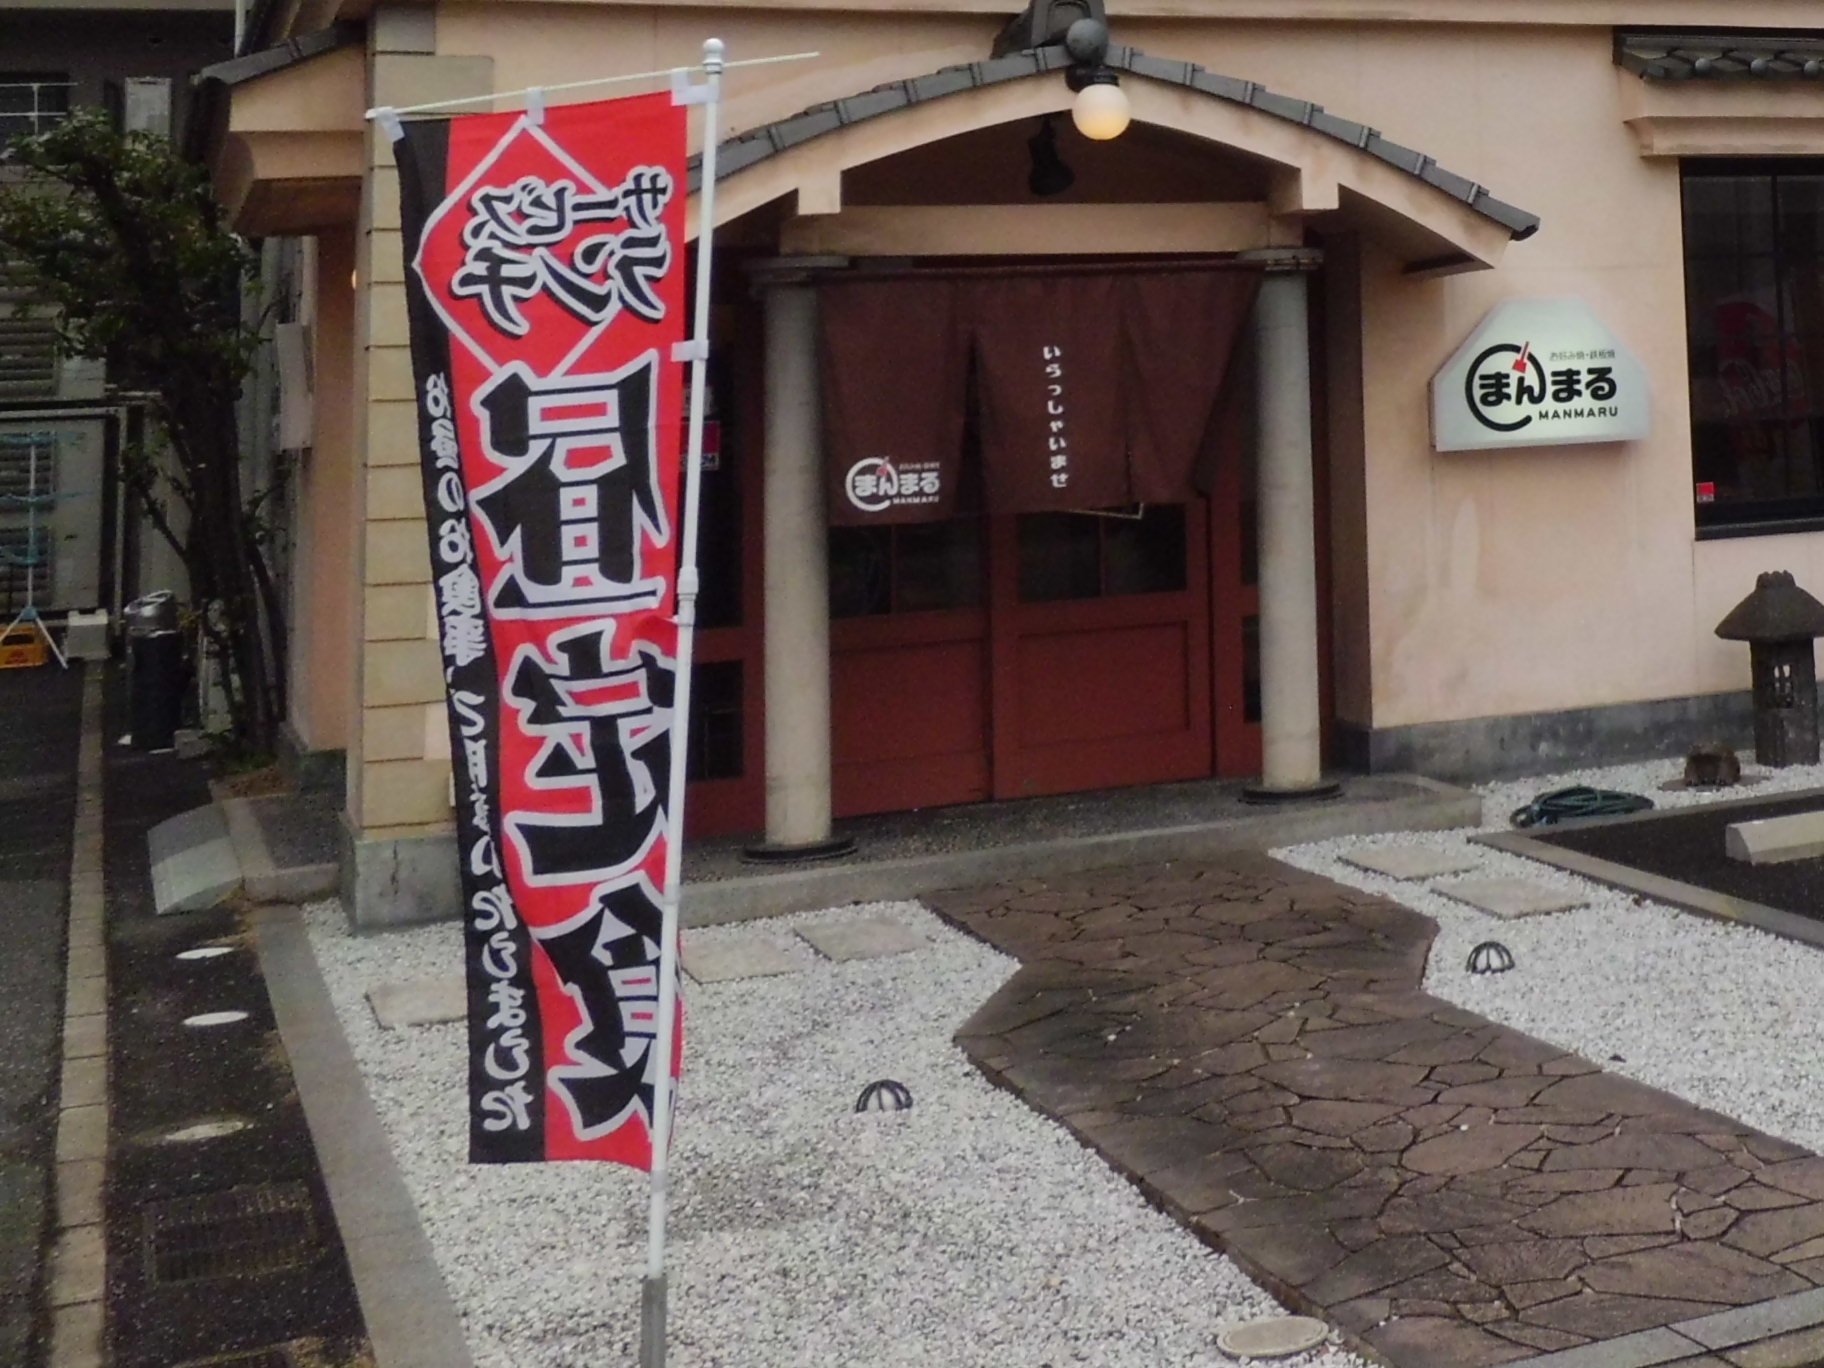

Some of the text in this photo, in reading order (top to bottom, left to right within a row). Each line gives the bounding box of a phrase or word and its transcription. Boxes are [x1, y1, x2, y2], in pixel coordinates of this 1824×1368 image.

[1043, 345, 1069, 488] いらっしゃいませ
[1538, 405, 1618, 421] MANMARU
